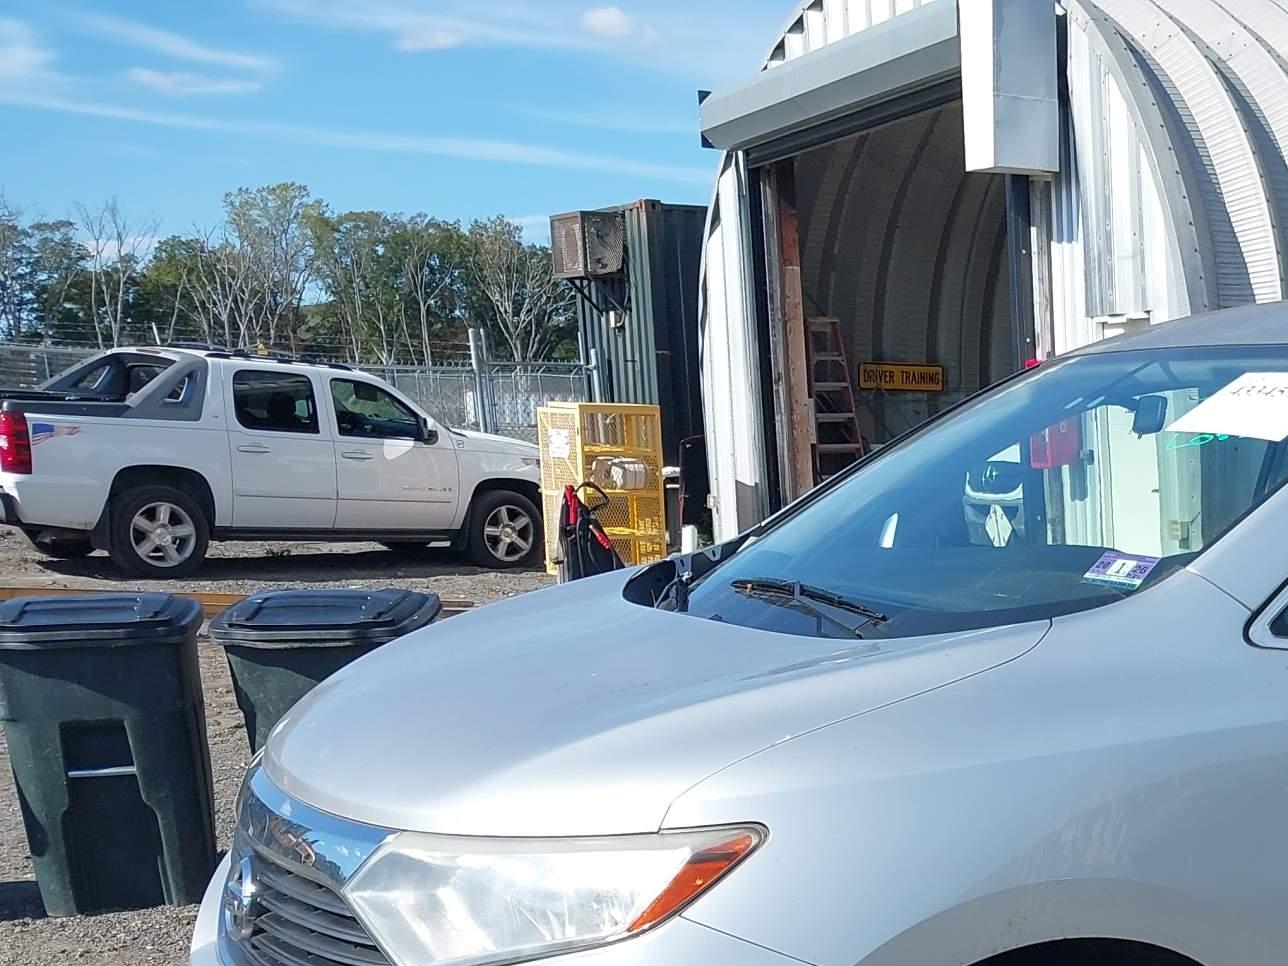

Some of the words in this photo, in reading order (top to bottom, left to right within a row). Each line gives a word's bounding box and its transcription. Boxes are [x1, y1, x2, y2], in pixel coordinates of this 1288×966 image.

[864, 368, 895, 384] DRIVER
[901, 370, 940, 385] TRAINING
[1095, 560, 1111, 570] 20
